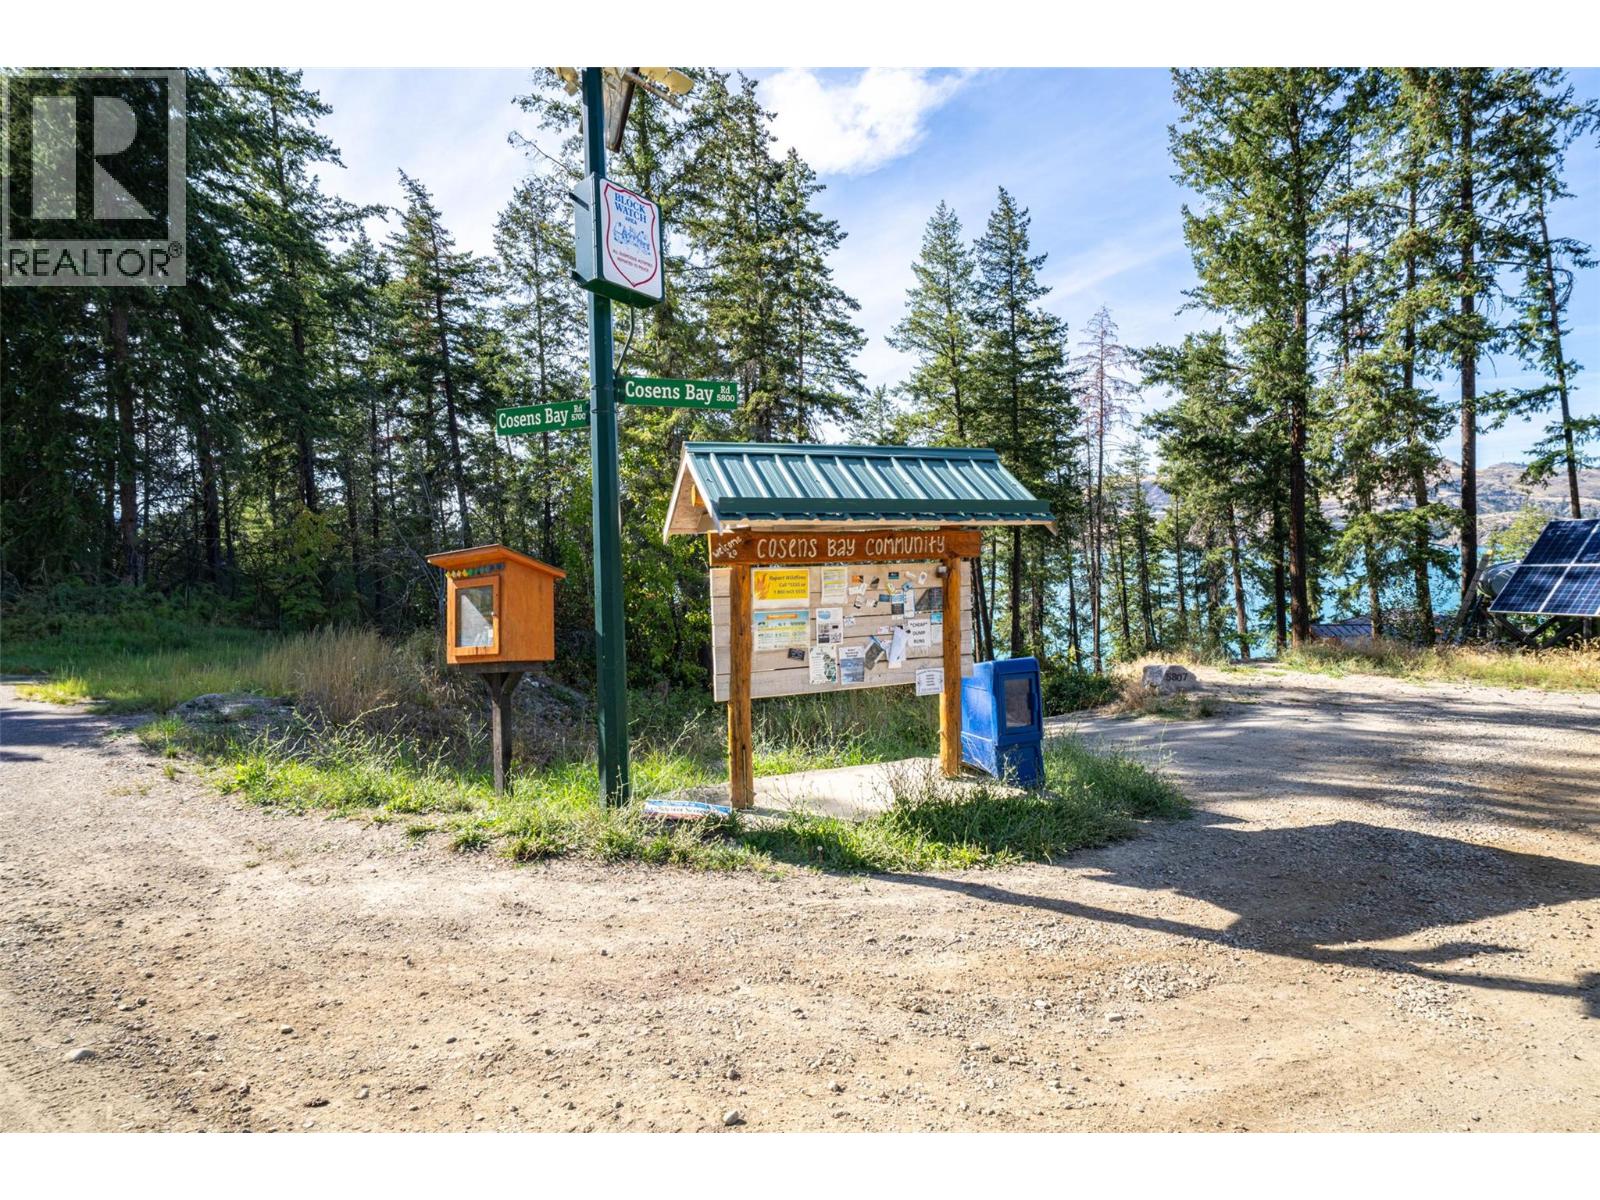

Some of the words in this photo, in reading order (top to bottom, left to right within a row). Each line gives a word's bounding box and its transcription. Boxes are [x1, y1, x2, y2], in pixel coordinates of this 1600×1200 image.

[615, 192, 646, 214] BLOCK
[615, 202, 647, 224] WATCH
[625, 380, 680, 399] Cosens
[685, 384, 714, 405] Bay
[720, 385, 731, 394] Rd
[716, 394, 736, 402] 5800
[499, 412, 542, 429] Cosens
[544, 408, 569, 427] Bay
[573, 404, 583, 412] Rd
[1165, 672, 1188, 682] 5807
